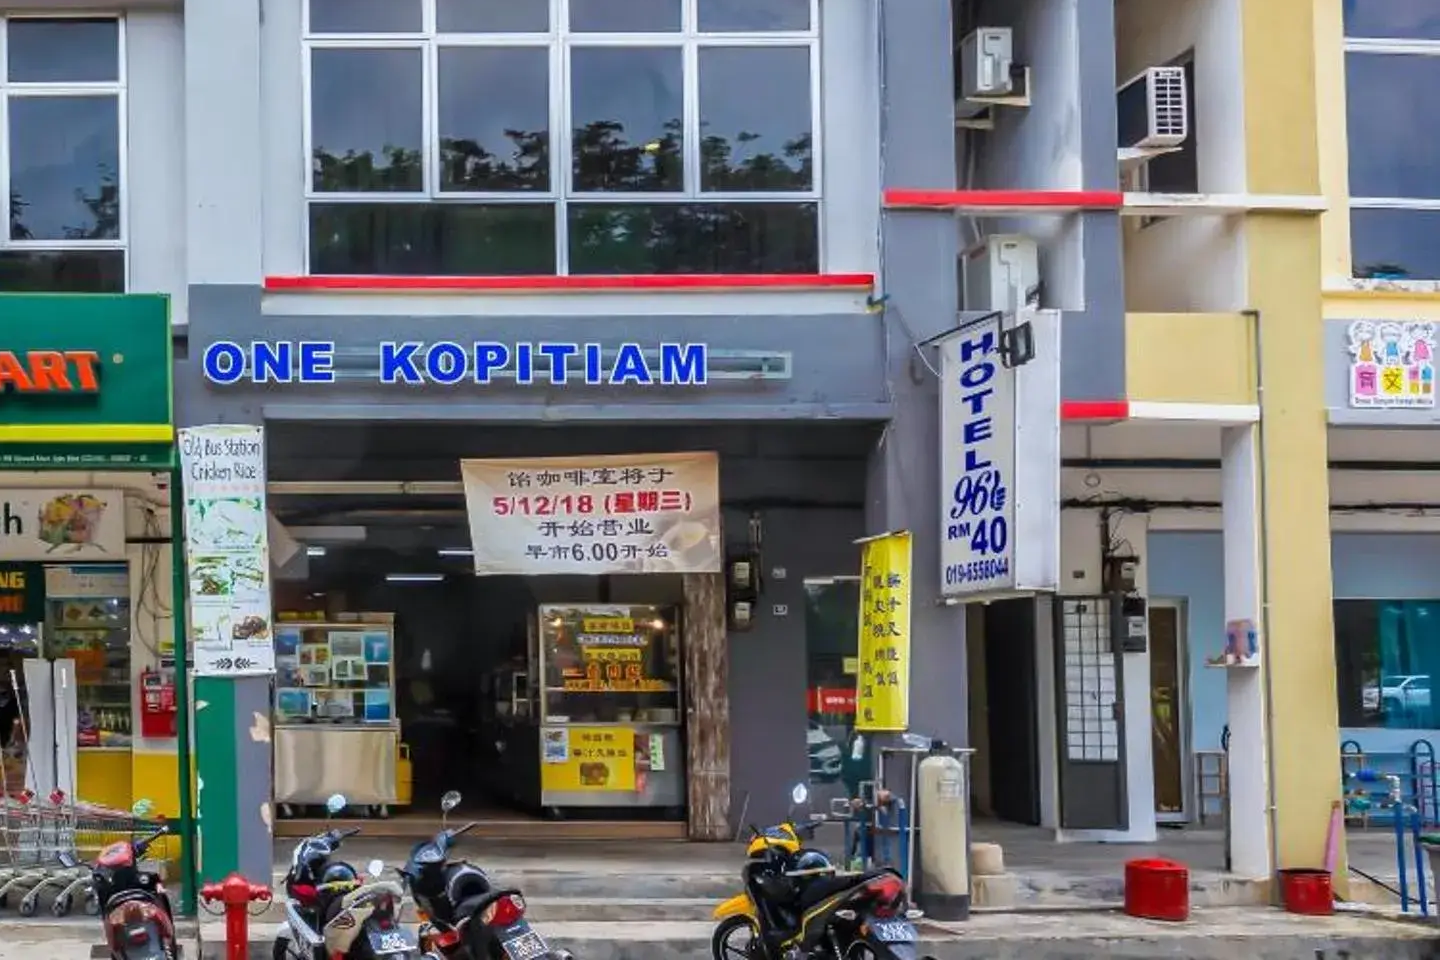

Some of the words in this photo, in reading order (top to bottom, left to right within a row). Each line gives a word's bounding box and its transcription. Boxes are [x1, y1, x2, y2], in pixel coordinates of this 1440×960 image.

[203, 341, 335, 385] ONE
[380, 342, 709, 386] KOPITIAM
[959, 331, 995, 472] HOTEL
[493, 496, 593, 515] 5/12/18
[604, 491, 691, 514] (星期三)
[538, 518, 654, 537] 开始营业
[948, 523, 970, 540] RM
[971, 516, 1007, 555] 40
